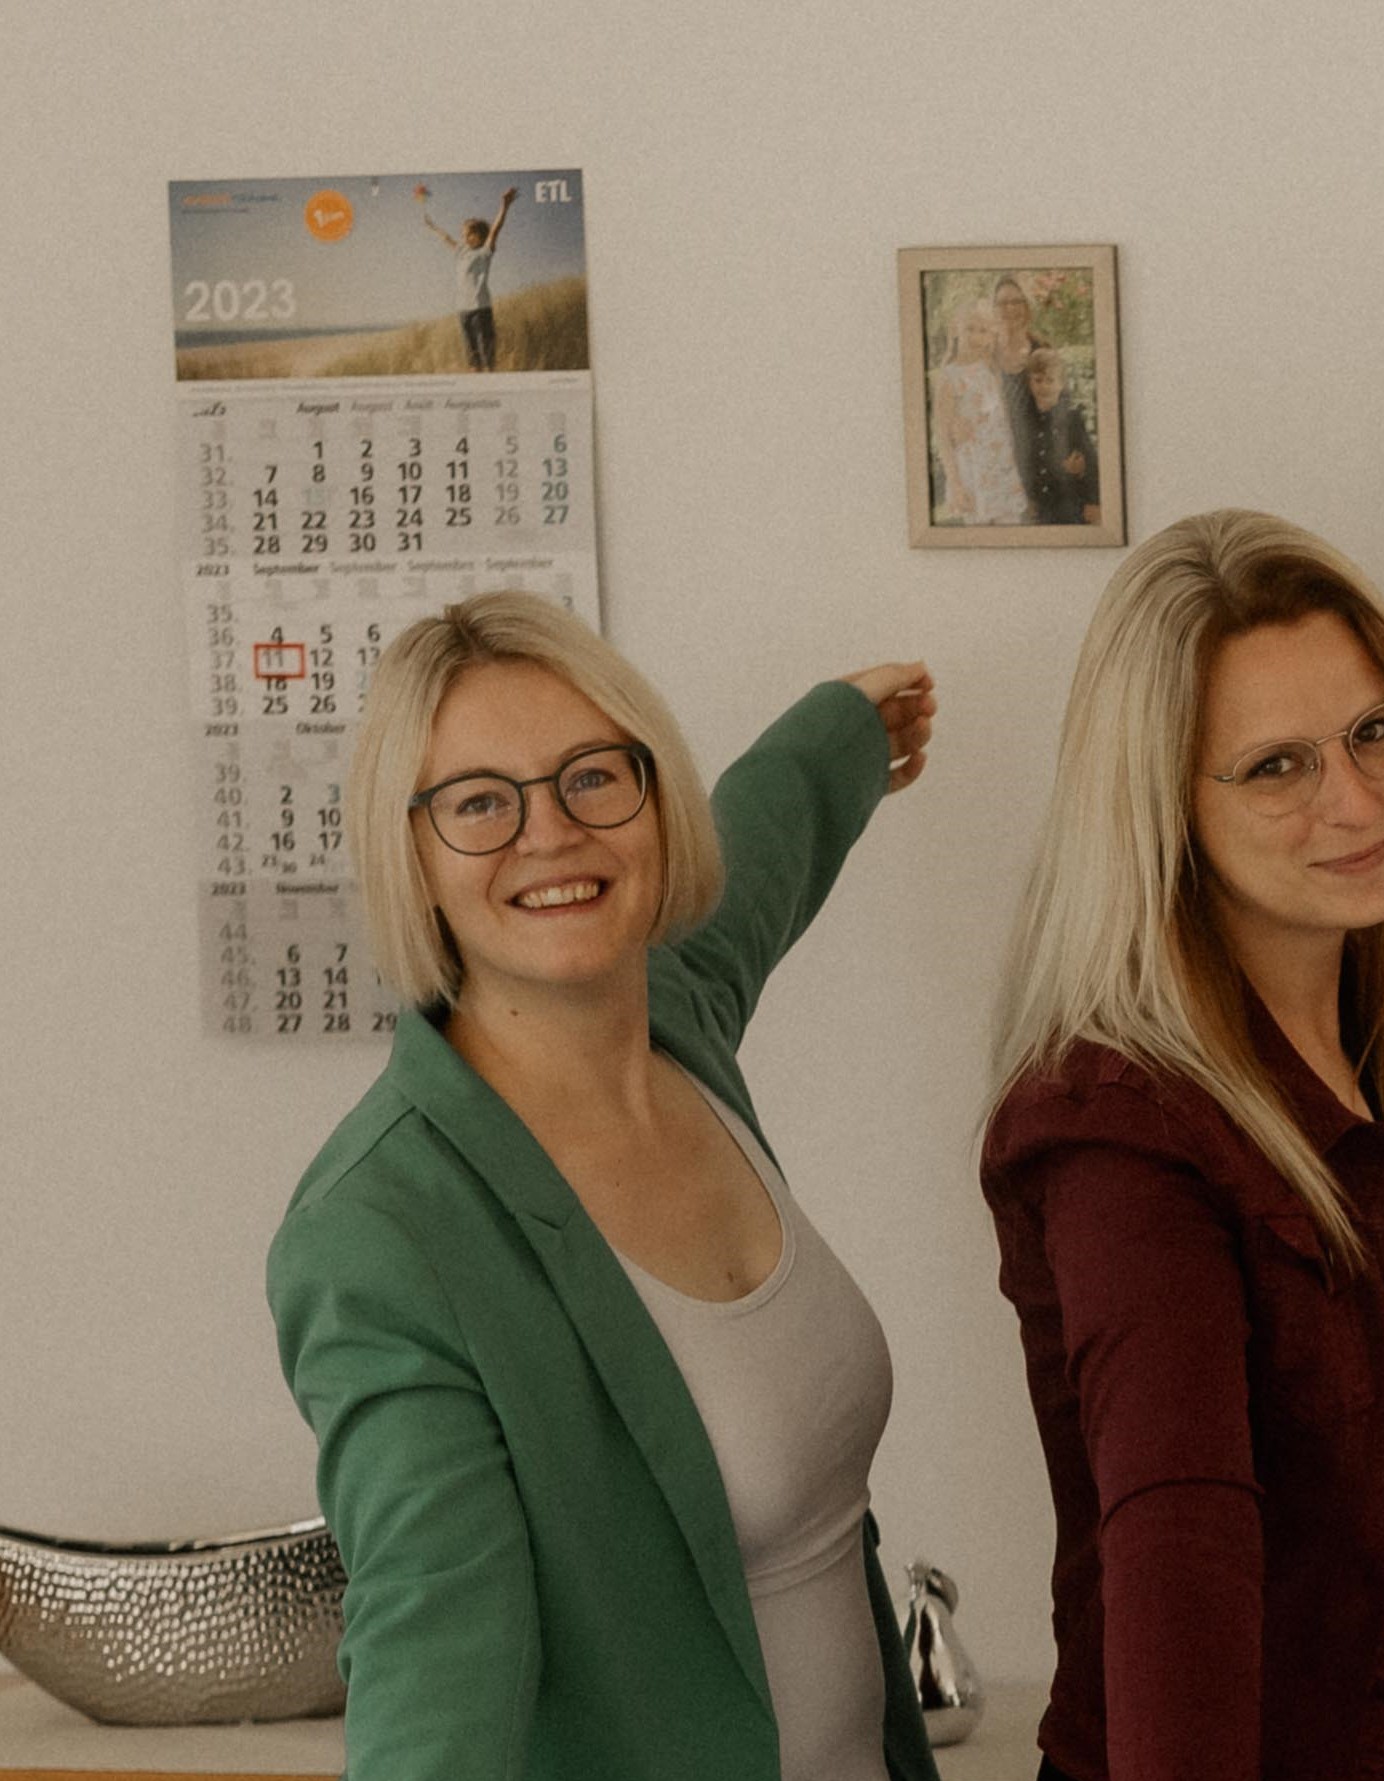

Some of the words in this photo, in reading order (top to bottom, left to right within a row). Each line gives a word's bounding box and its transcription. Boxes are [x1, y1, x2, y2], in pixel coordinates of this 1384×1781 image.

[535, 180, 571, 203] ETL
[185, 279, 296, 322] 2023
[297, 401, 341, 415] August
[313, 441, 323, 458] 1
[361, 440, 373, 458] 2
[410, 439, 422, 456] 3
[455, 438, 469, 455] 4
[505, 436, 518, 454] 5
[554, 434, 567, 452] 6
[265, 466, 278, 484] 7
[313, 465, 325, 482] 8
[361, 464, 373, 481] 9
[398, 463, 422, 480] 10
[446, 462, 469, 479] 11
[494, 461, 518, 479] 12
[542, 458, 568, 477] 13
[253, 488, 278, 507] 14
[349, 487, 374, 505] 16
[397, 485, 422, 504] 17
[446, 485, 471, 503] 18
[495, 483, 520, 501] 19
[542, 482, 568, 500] 20
[253, 512, 277, 531] 21
[301, 511, 326, 530] 22
[348, 510, 375, 528] 23
[396, 509, 423, 527] 24
[445, 509, 472, 527] 25
[494, 506, 521, 525] 26
[542, 505, 569, 524] 27
[253, 536, 280, 554] 28
[301, 535, 328, 553] 29
[349, 534, 376, 552] 30
[398, 533, 422, 551] 31
[253, 560, 320, 575] September
[329, 560, 397, 575] September
[320, 625, 332, 643] 5
[367, 624, 380, 642] 6
[263, 650, 283, 667] 11
[309, 650, 333, 668] 12
[311, 673, 335, 690] 19
[262, 696, 289, 714] 25
[310, 695, 336, 713] 26
[296, 722, 345, 735] Oktober
[281, 787, 292, 805] 2
[328, 785, 340, 803] 3
[282, 810, 293, 828] 9
[318, 810, 340, 827] 10
[271, 833, 294, 851] 16
[319, 833, 342, 850] 17
[288, 945, 300, 963] 6
[337, 945, 347, 962] 7
[276, 968, 301, 986] 13
[324, 968, 348, 985] 14
[276, 991, 302, 1009] 20
[324, 991, 347, 1008] 21
[277, 1014, 302, 1032] 27
[323, 1014, 351, 1031] 28
[371, 1013, 397, 1031] 29
